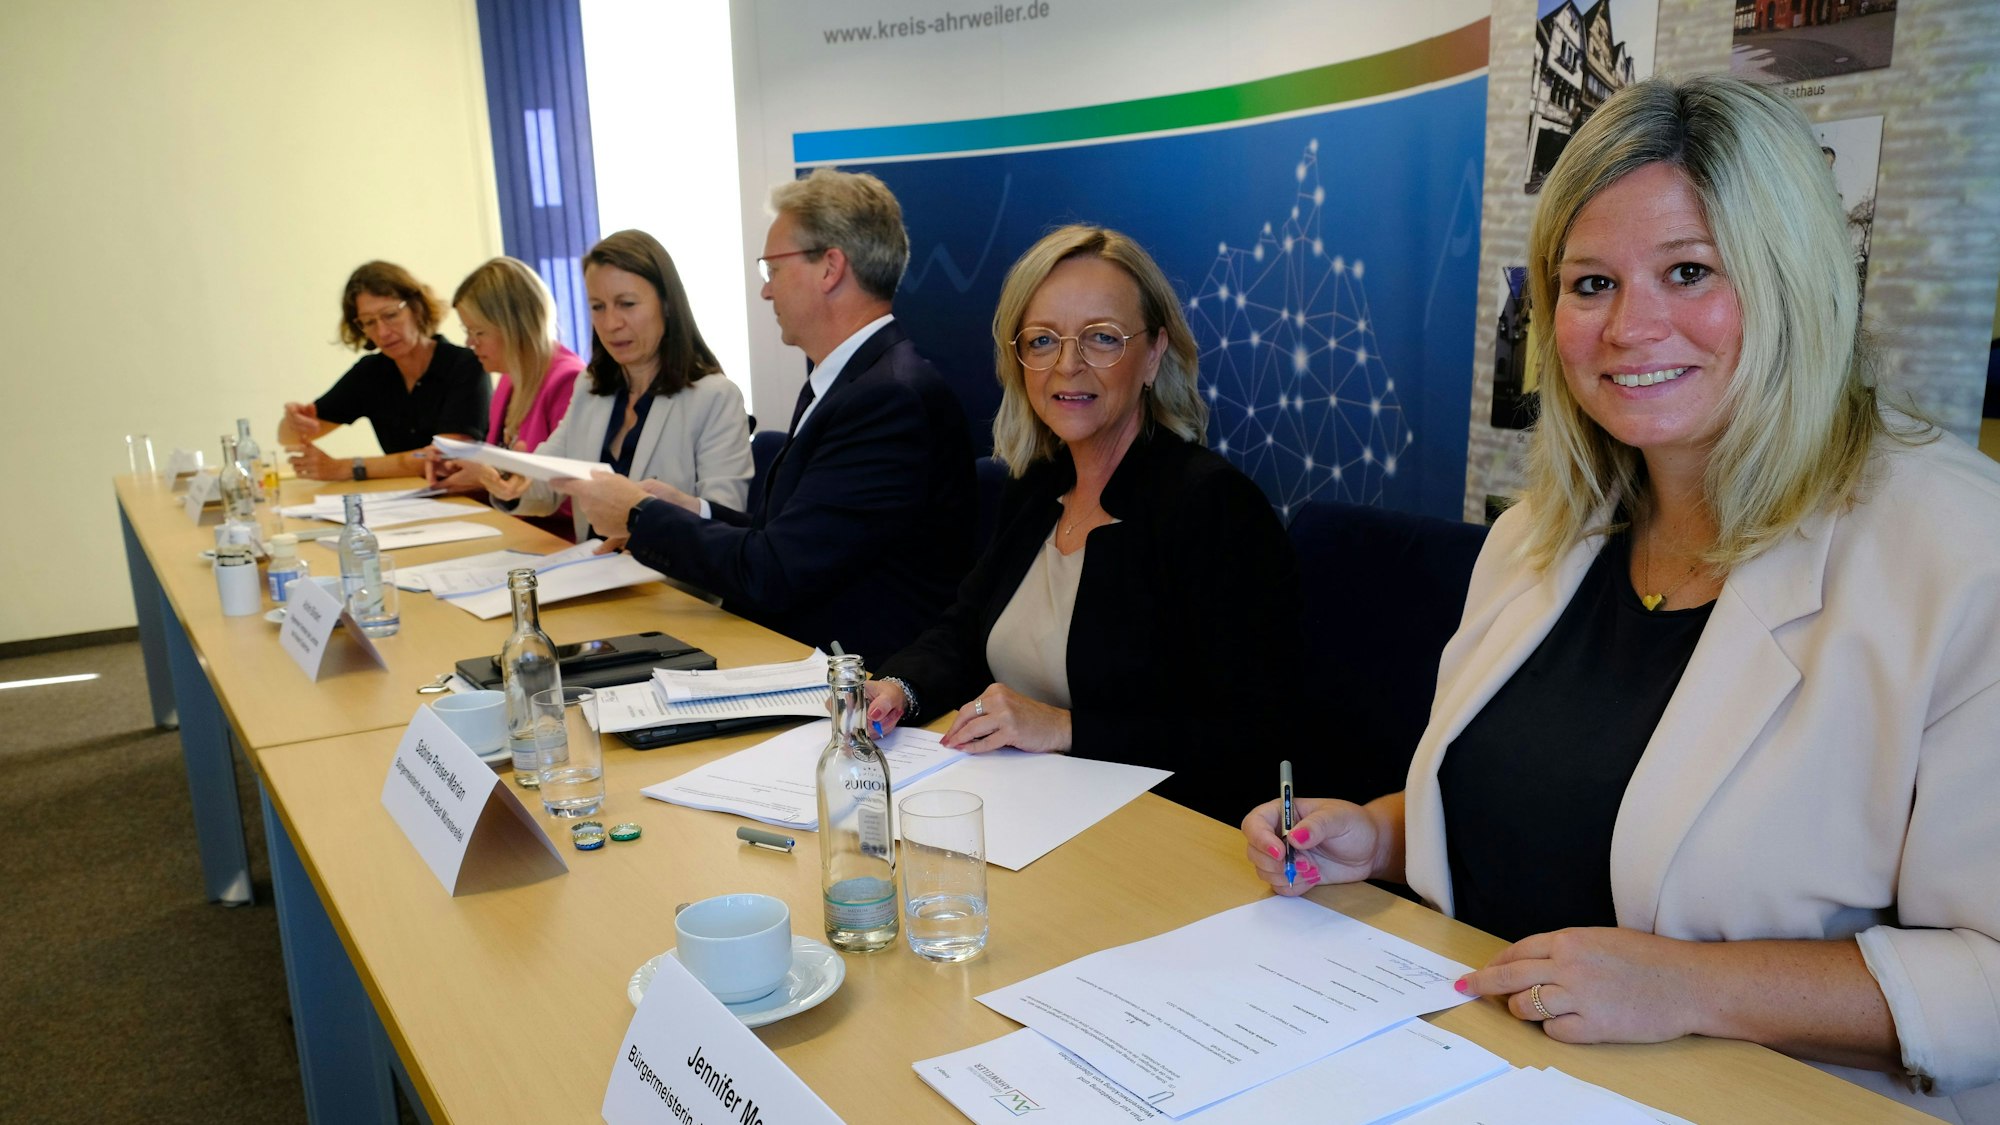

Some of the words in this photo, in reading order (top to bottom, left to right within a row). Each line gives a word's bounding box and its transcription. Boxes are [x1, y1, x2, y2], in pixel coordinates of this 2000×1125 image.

[824, 0, 1049, 44] www.kreis-ahrweiler.de
[628, 1044, 693, 1125] Bürgermeisterin
[688, 1046, 742, 1113] Jennifer
[974, 1063, 1012, 1090] AHRWEILER
[1076, 1076, 1090, 1084] und
[1092, 1075, 1104, 1084] von
[1120, 1104, 1131, 1112] zur
[1130, 1112, 1145, 1122] Plan
